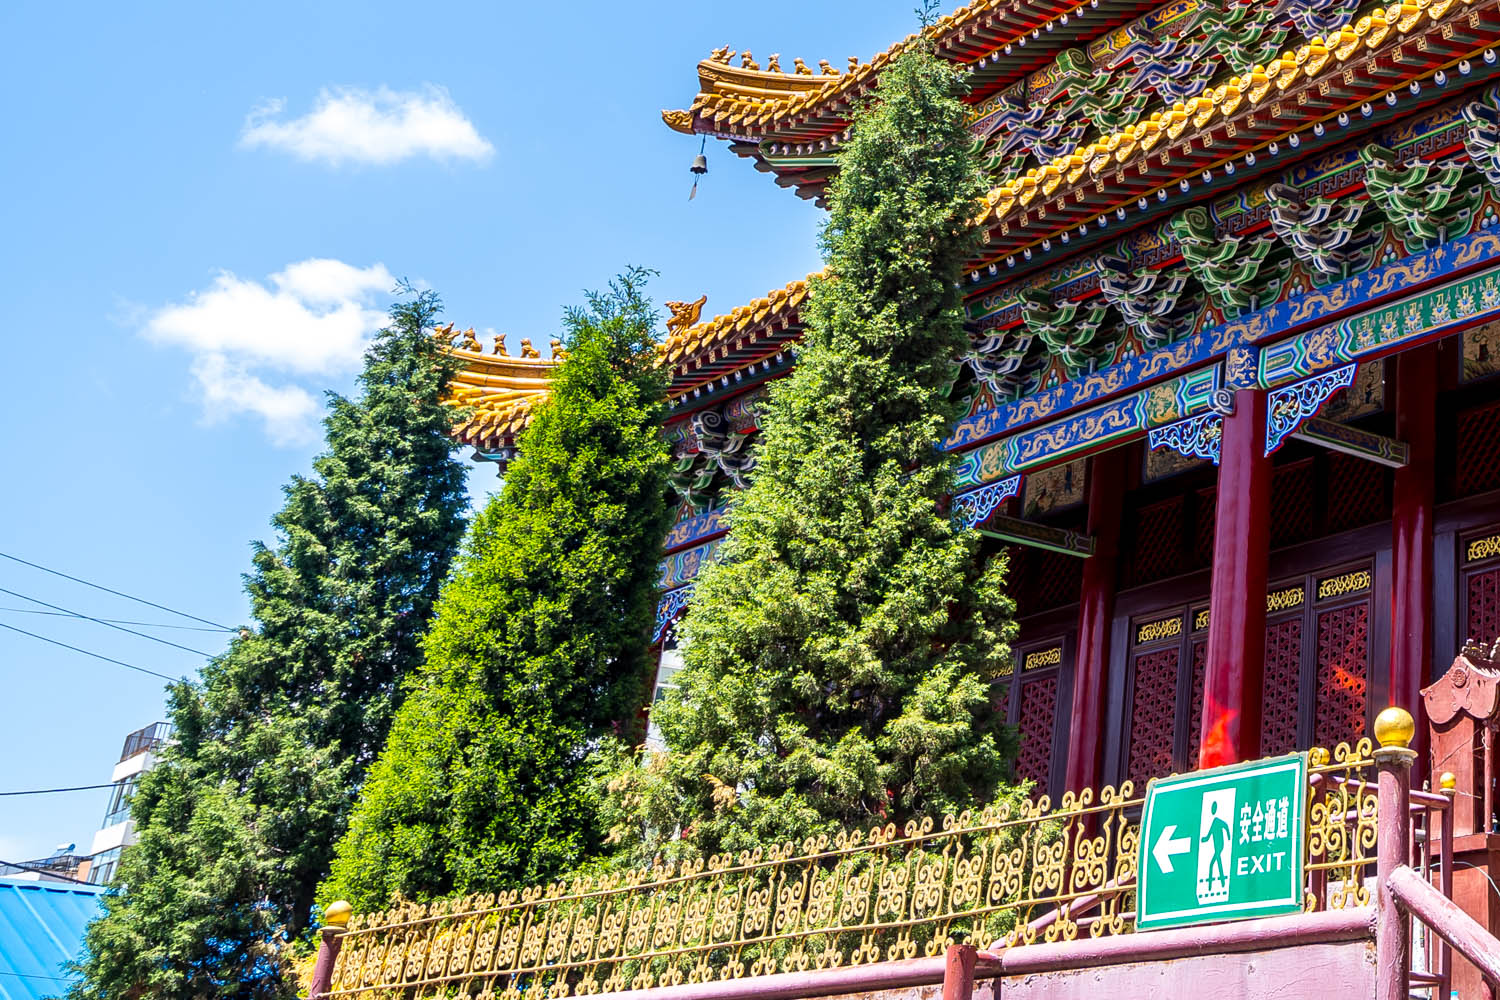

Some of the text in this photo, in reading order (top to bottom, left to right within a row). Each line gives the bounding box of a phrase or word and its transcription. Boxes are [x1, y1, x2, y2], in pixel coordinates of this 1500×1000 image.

[1239, 796, 1290, 846] 安全通道
[1236, 851, 1286, 876] EXIT
